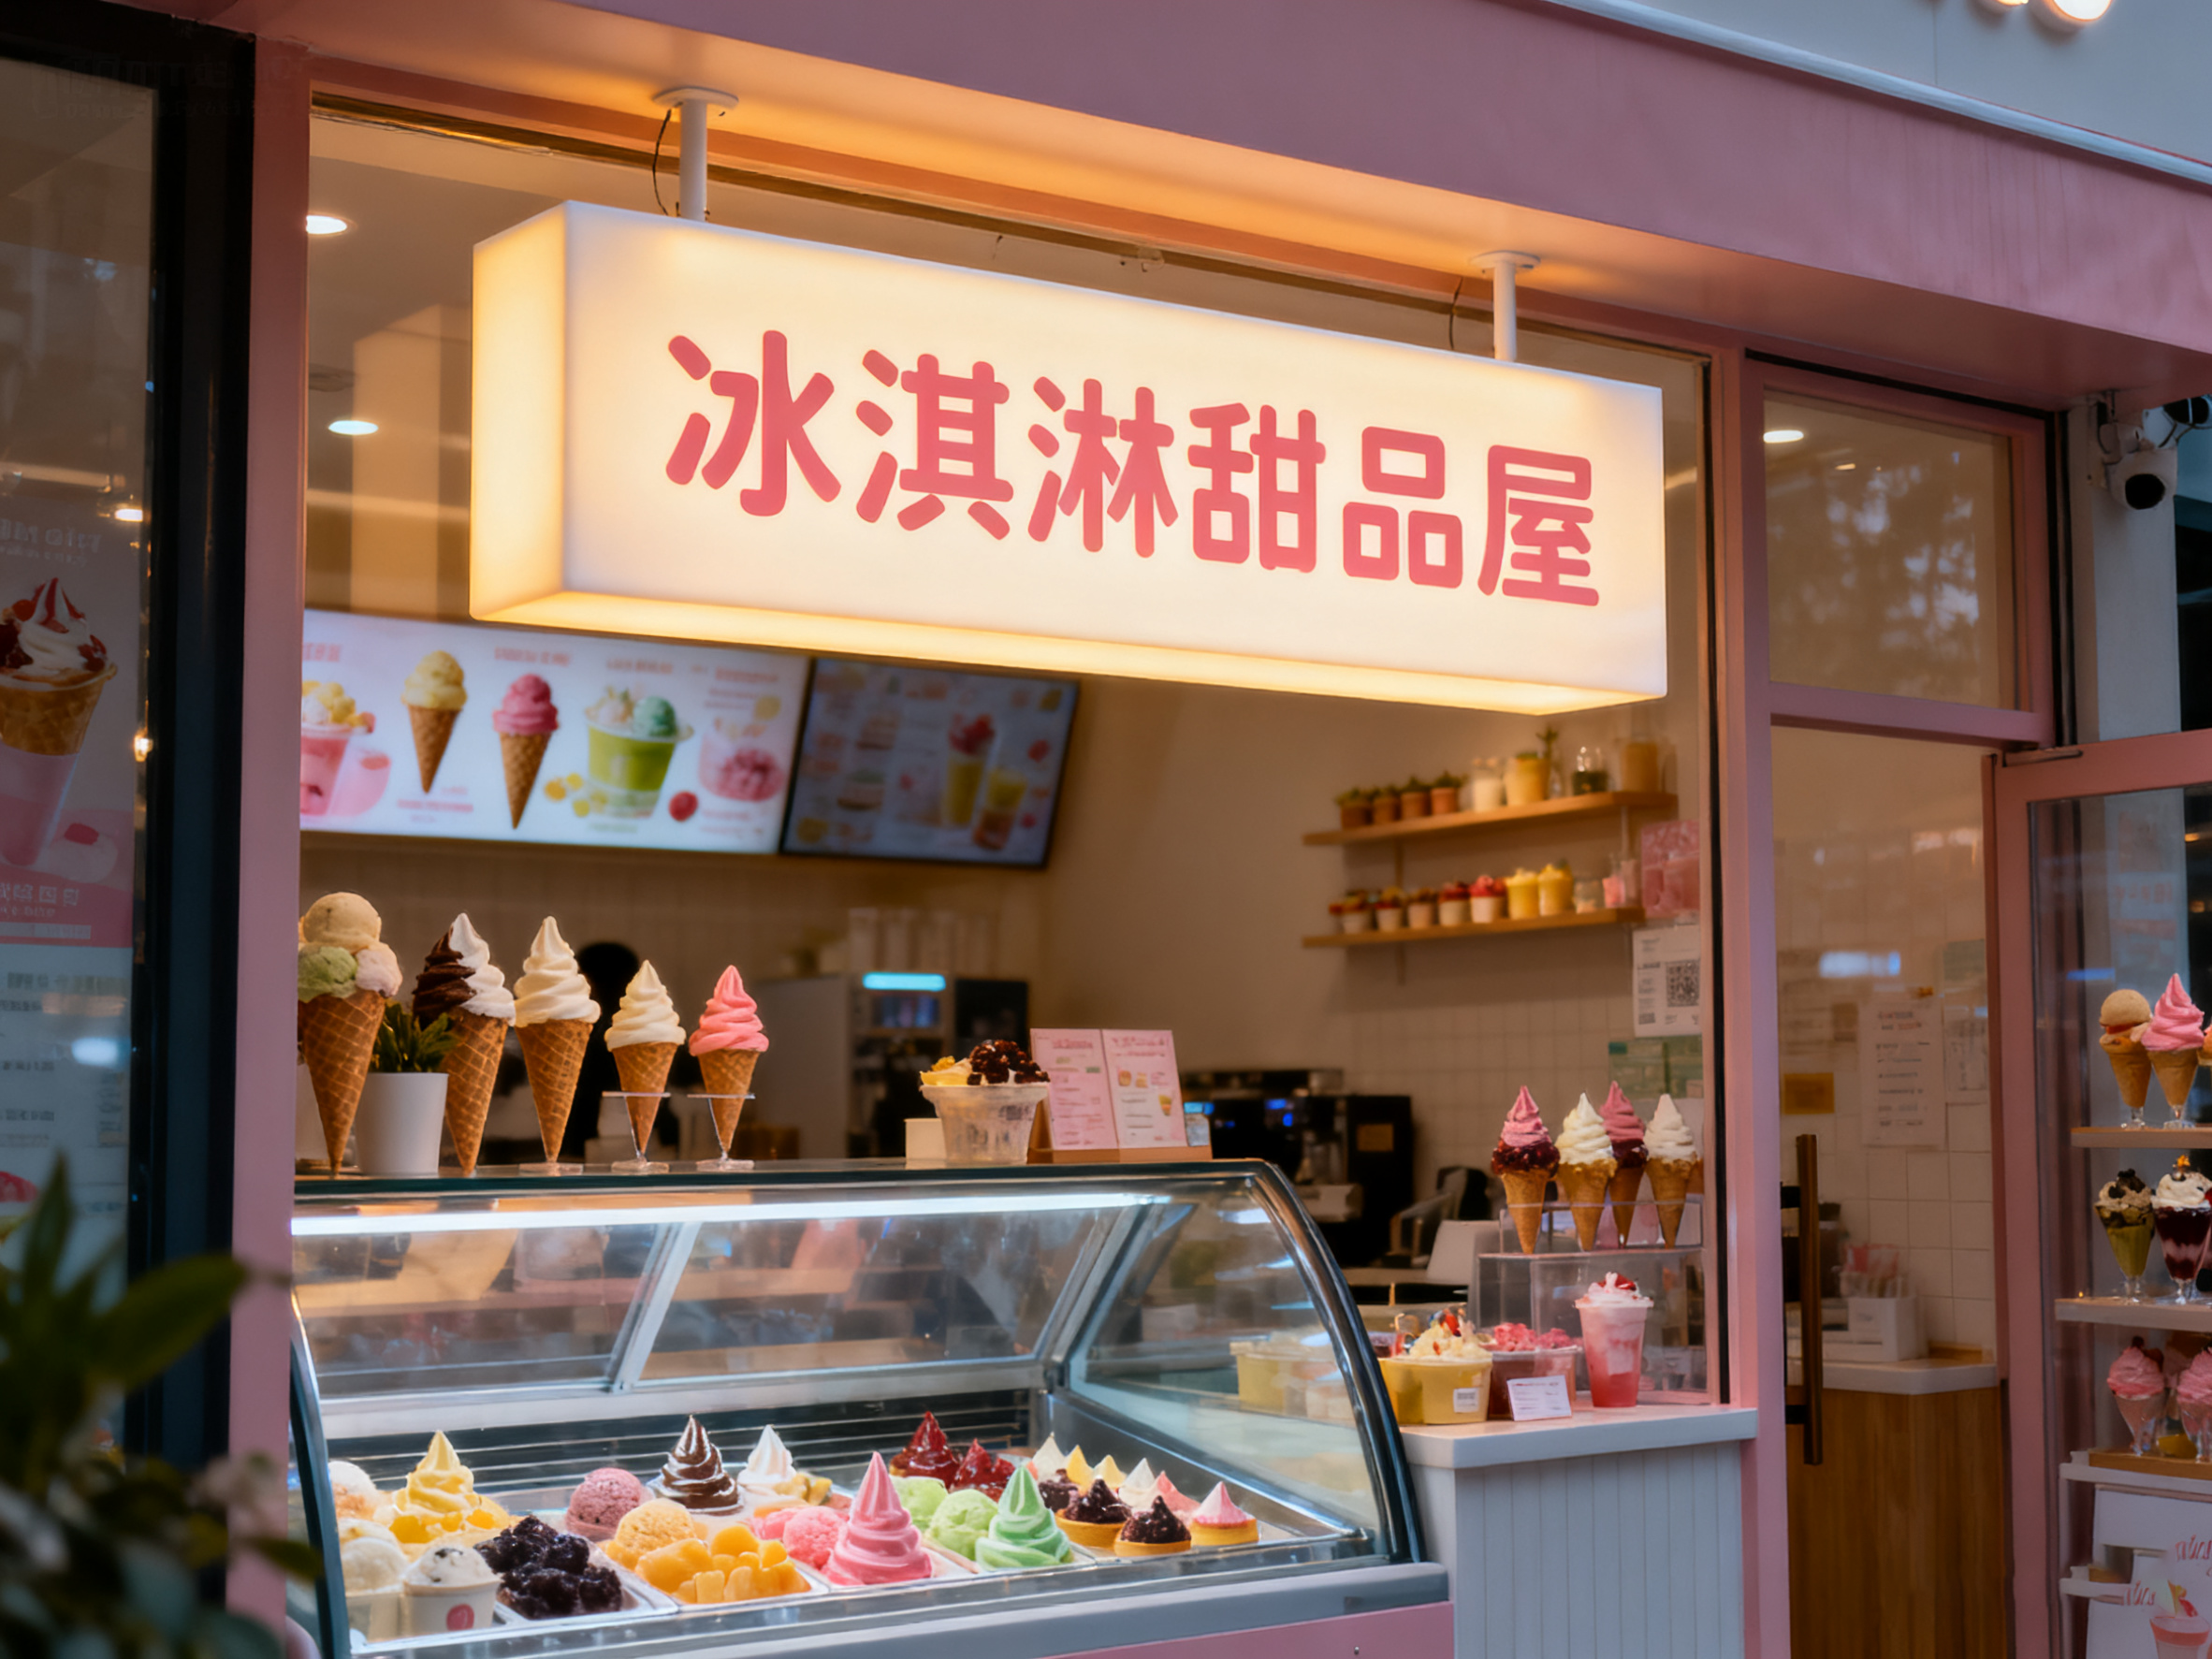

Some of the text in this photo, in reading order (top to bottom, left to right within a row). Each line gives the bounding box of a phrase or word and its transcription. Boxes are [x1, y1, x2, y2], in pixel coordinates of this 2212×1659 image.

[665, 329, 1600, 607] 冰淇淋甜品屋
